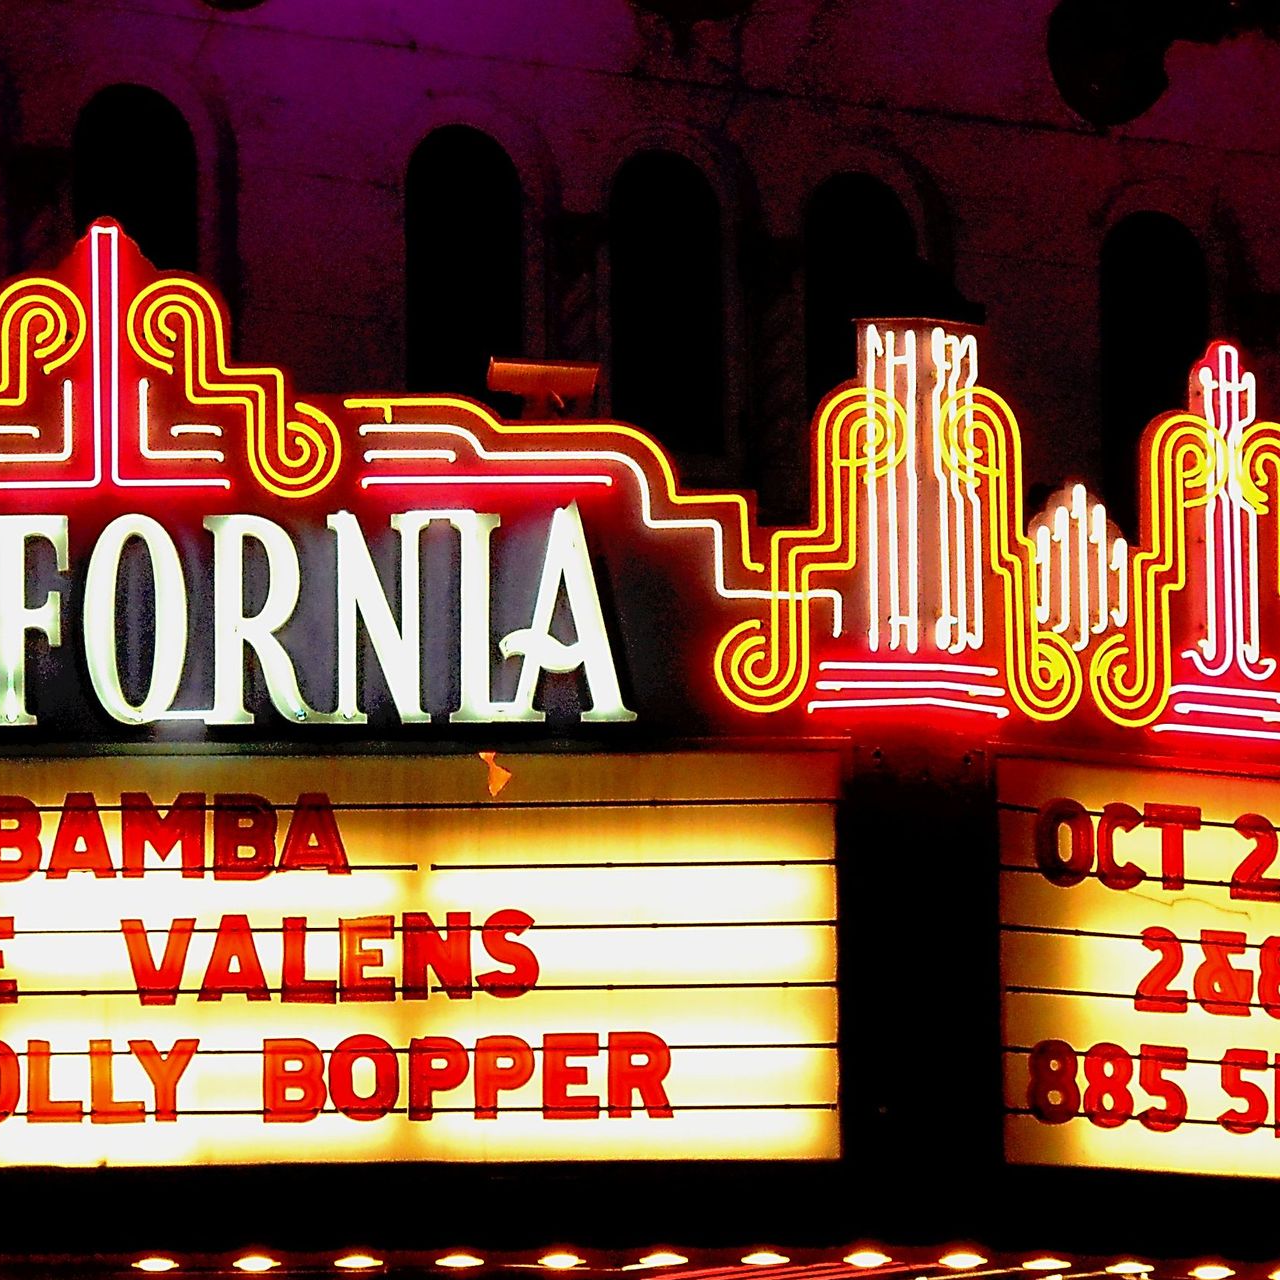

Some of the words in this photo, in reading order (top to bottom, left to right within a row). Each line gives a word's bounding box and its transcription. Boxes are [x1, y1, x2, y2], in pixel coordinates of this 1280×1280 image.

[1036, 798, 1202, 891] OCT
[120, 908, 540, 1006] VALENS
[263, 1031, 674, 1124] BOPPER
[1027, 1038, 1189, 1133] 885
